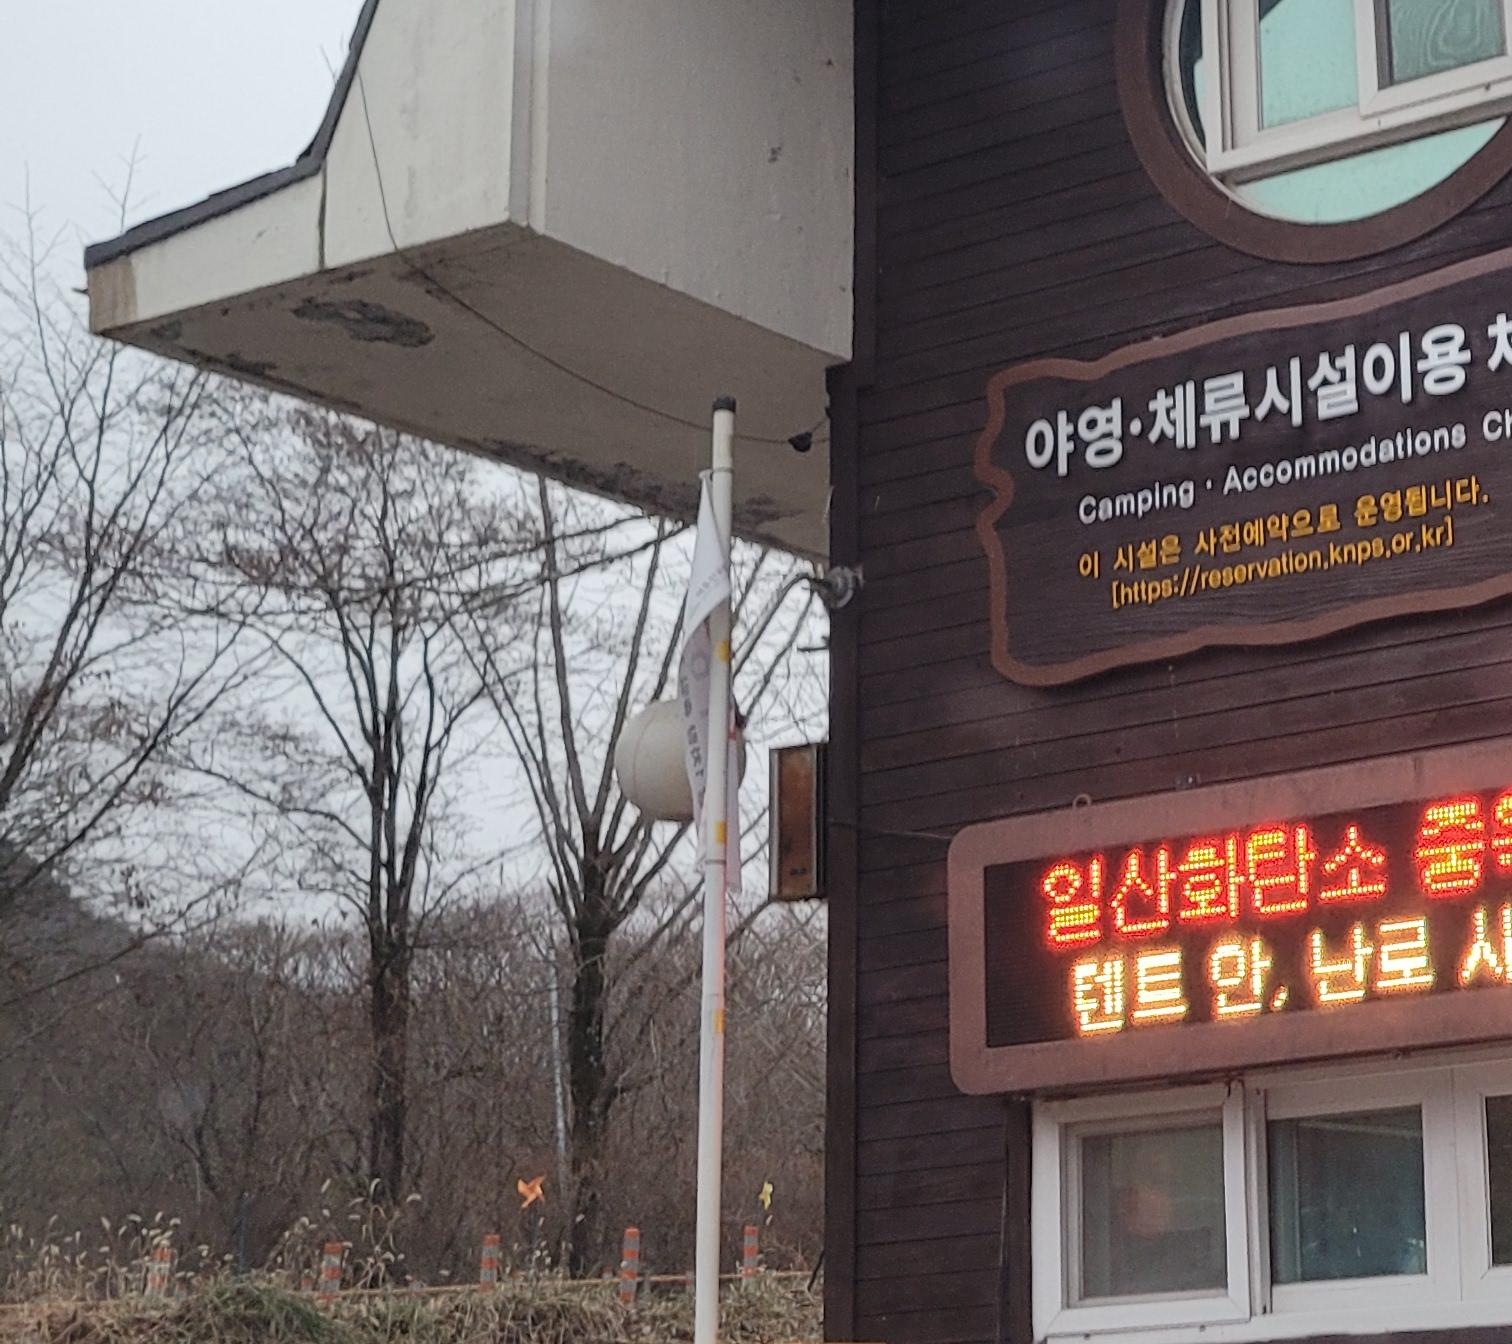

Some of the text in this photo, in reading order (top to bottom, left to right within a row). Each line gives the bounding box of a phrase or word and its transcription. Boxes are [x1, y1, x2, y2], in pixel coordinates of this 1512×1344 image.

[1024, 323, 1472, 476] 야영·체류시설이용
[1077, 480, 1196, 524] Camping
[1222, 420, 1467, 495] Accommodations
[1078, 550, 1100, 579] 이
[1113, 533, 1182, 573] 시설은
[1193, 503, 1341, 557] 사전예약으로
[1040, 822, 1390, 950] 일산화탄소
[1070, 947, 1190, 1036] 텐트
[1308, 914, 1438, 1006] 난로
